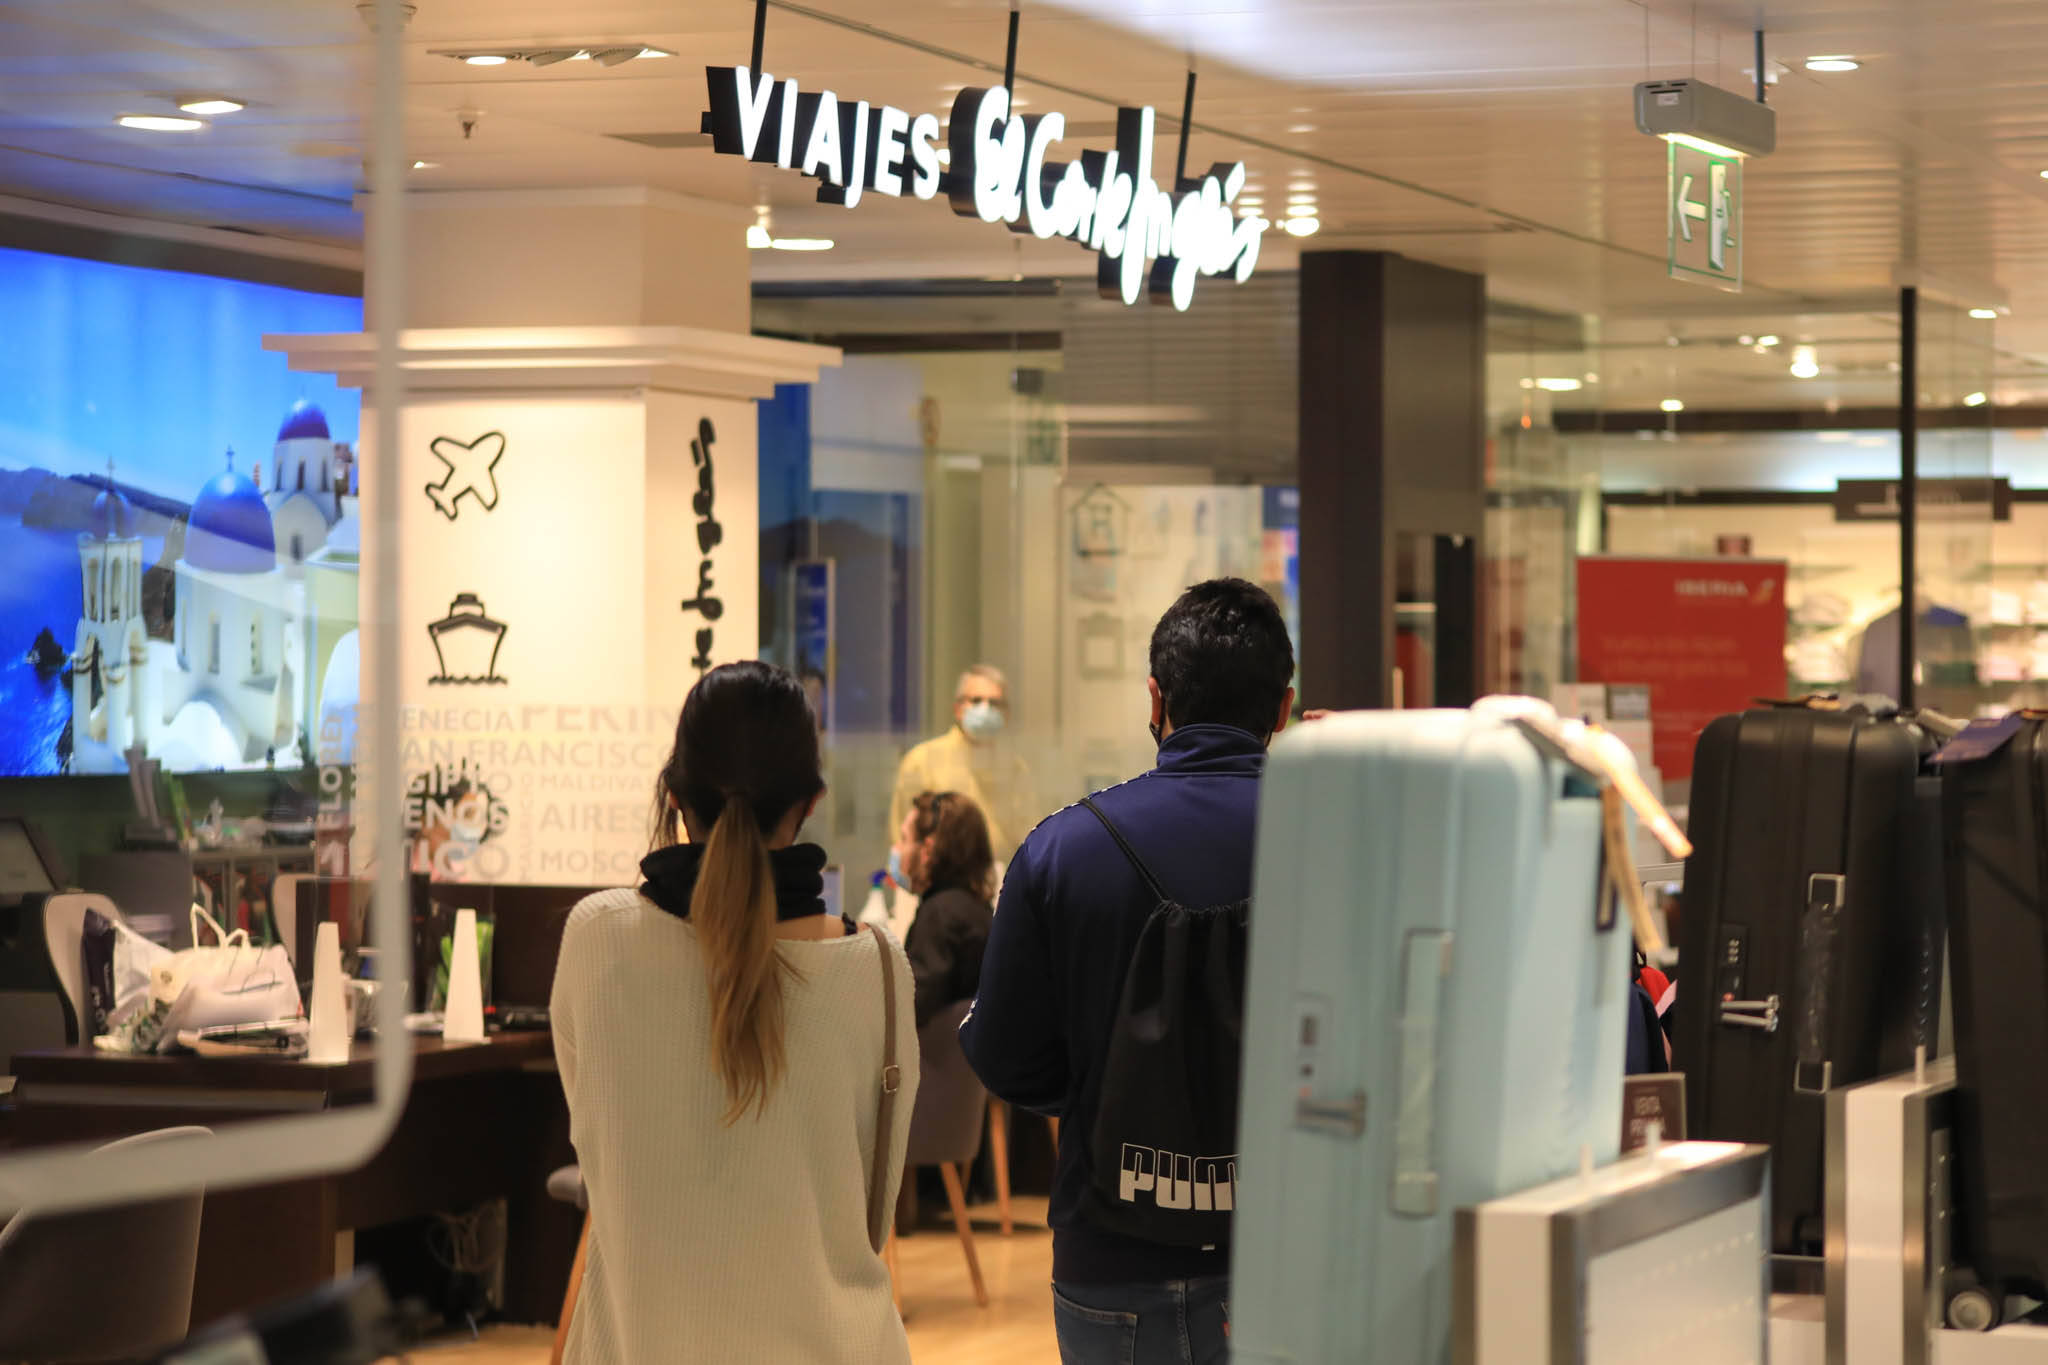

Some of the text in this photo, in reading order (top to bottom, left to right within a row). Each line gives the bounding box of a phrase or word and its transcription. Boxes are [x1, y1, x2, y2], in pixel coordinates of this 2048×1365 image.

[736, 65, 940, 208] VIAJES
[402, 706, 514, 732] ENECIA
[401, 738, 453, 767] AN
[406, 766, 511, 795] GIPTO
[404, 799, 510, 835] ENOS
[539, 801, 648, 833] AIRES
[540, 849, 642, 874] MOSC
[1119, 1143, 1241, 1211] PUM
